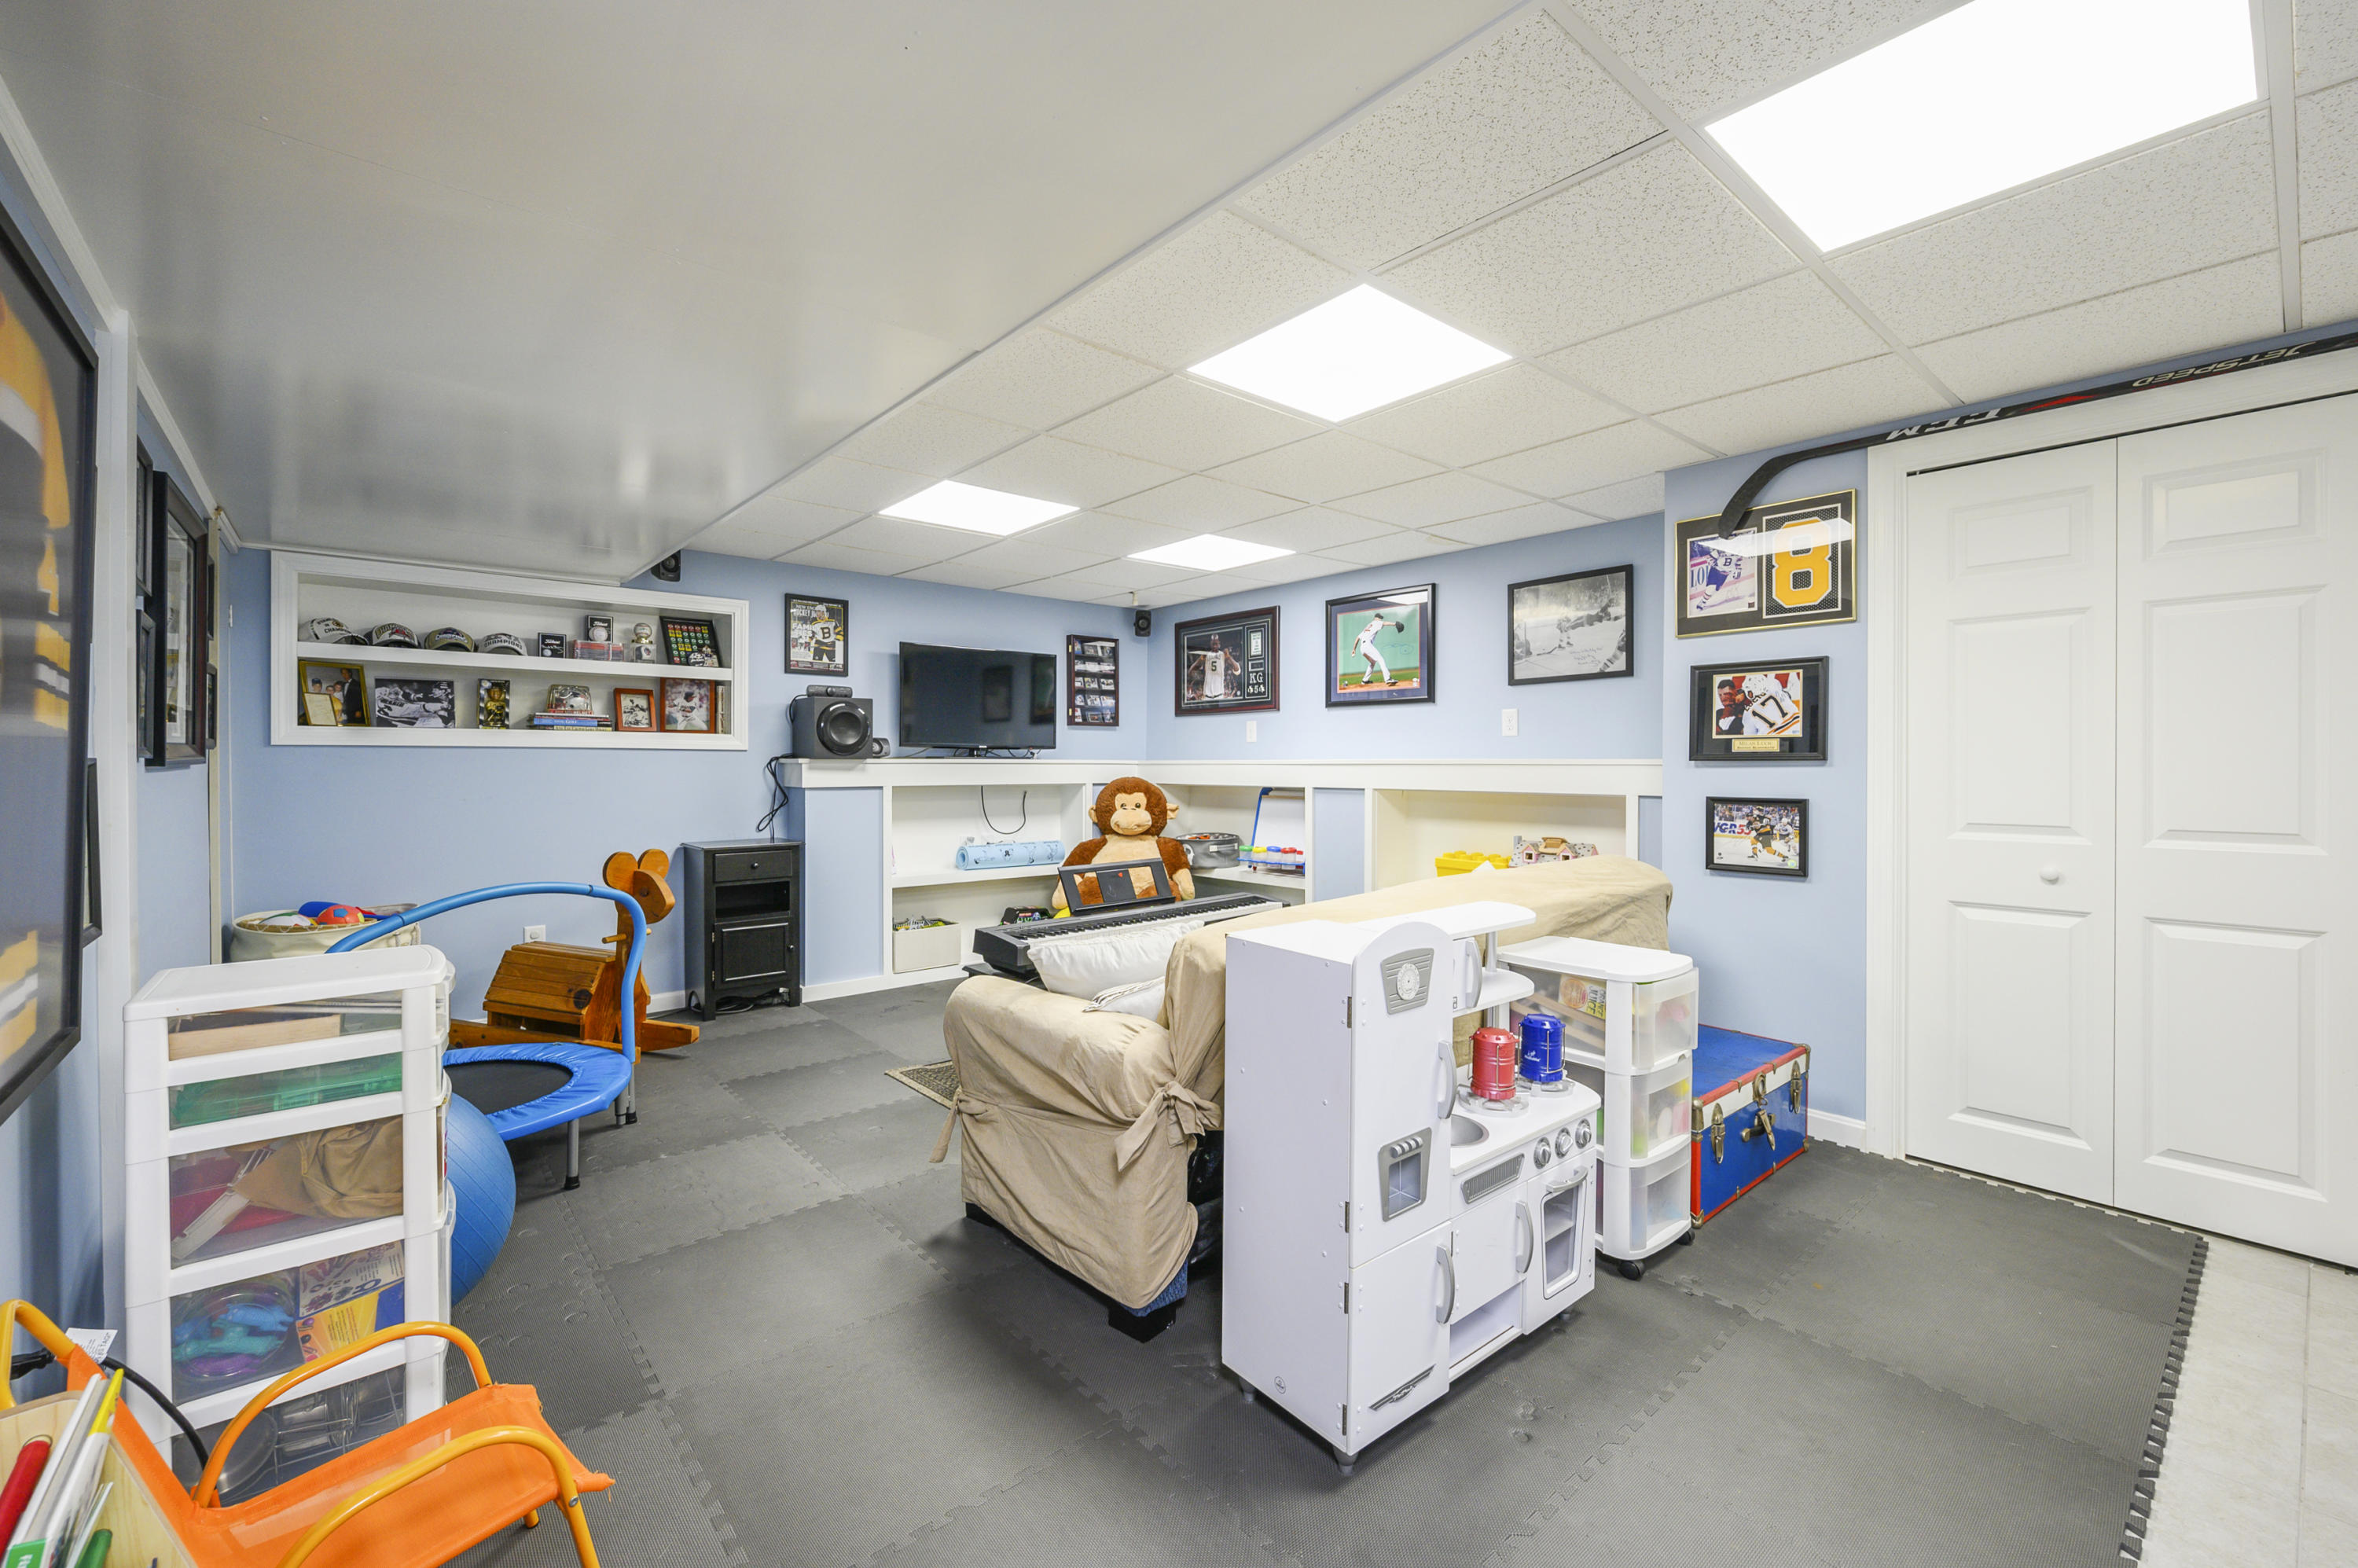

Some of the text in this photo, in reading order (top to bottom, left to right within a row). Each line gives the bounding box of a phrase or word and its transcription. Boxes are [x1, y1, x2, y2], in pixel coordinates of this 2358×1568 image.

[2132, 341, 2316, 387] JETSPEED
[1723, 557, 1732, 567] B
[1773, 516, 1833, 608] 8
[820, 626, 831, 640] B
[1211, 661, 1218, 672] 5
[1249, 672, 1264, 685] KG
[1254, 685, 1259, 693] 5
[1751, 695, 1789, 729] 17
[1588, 986, 1599, 1015] JUICE
